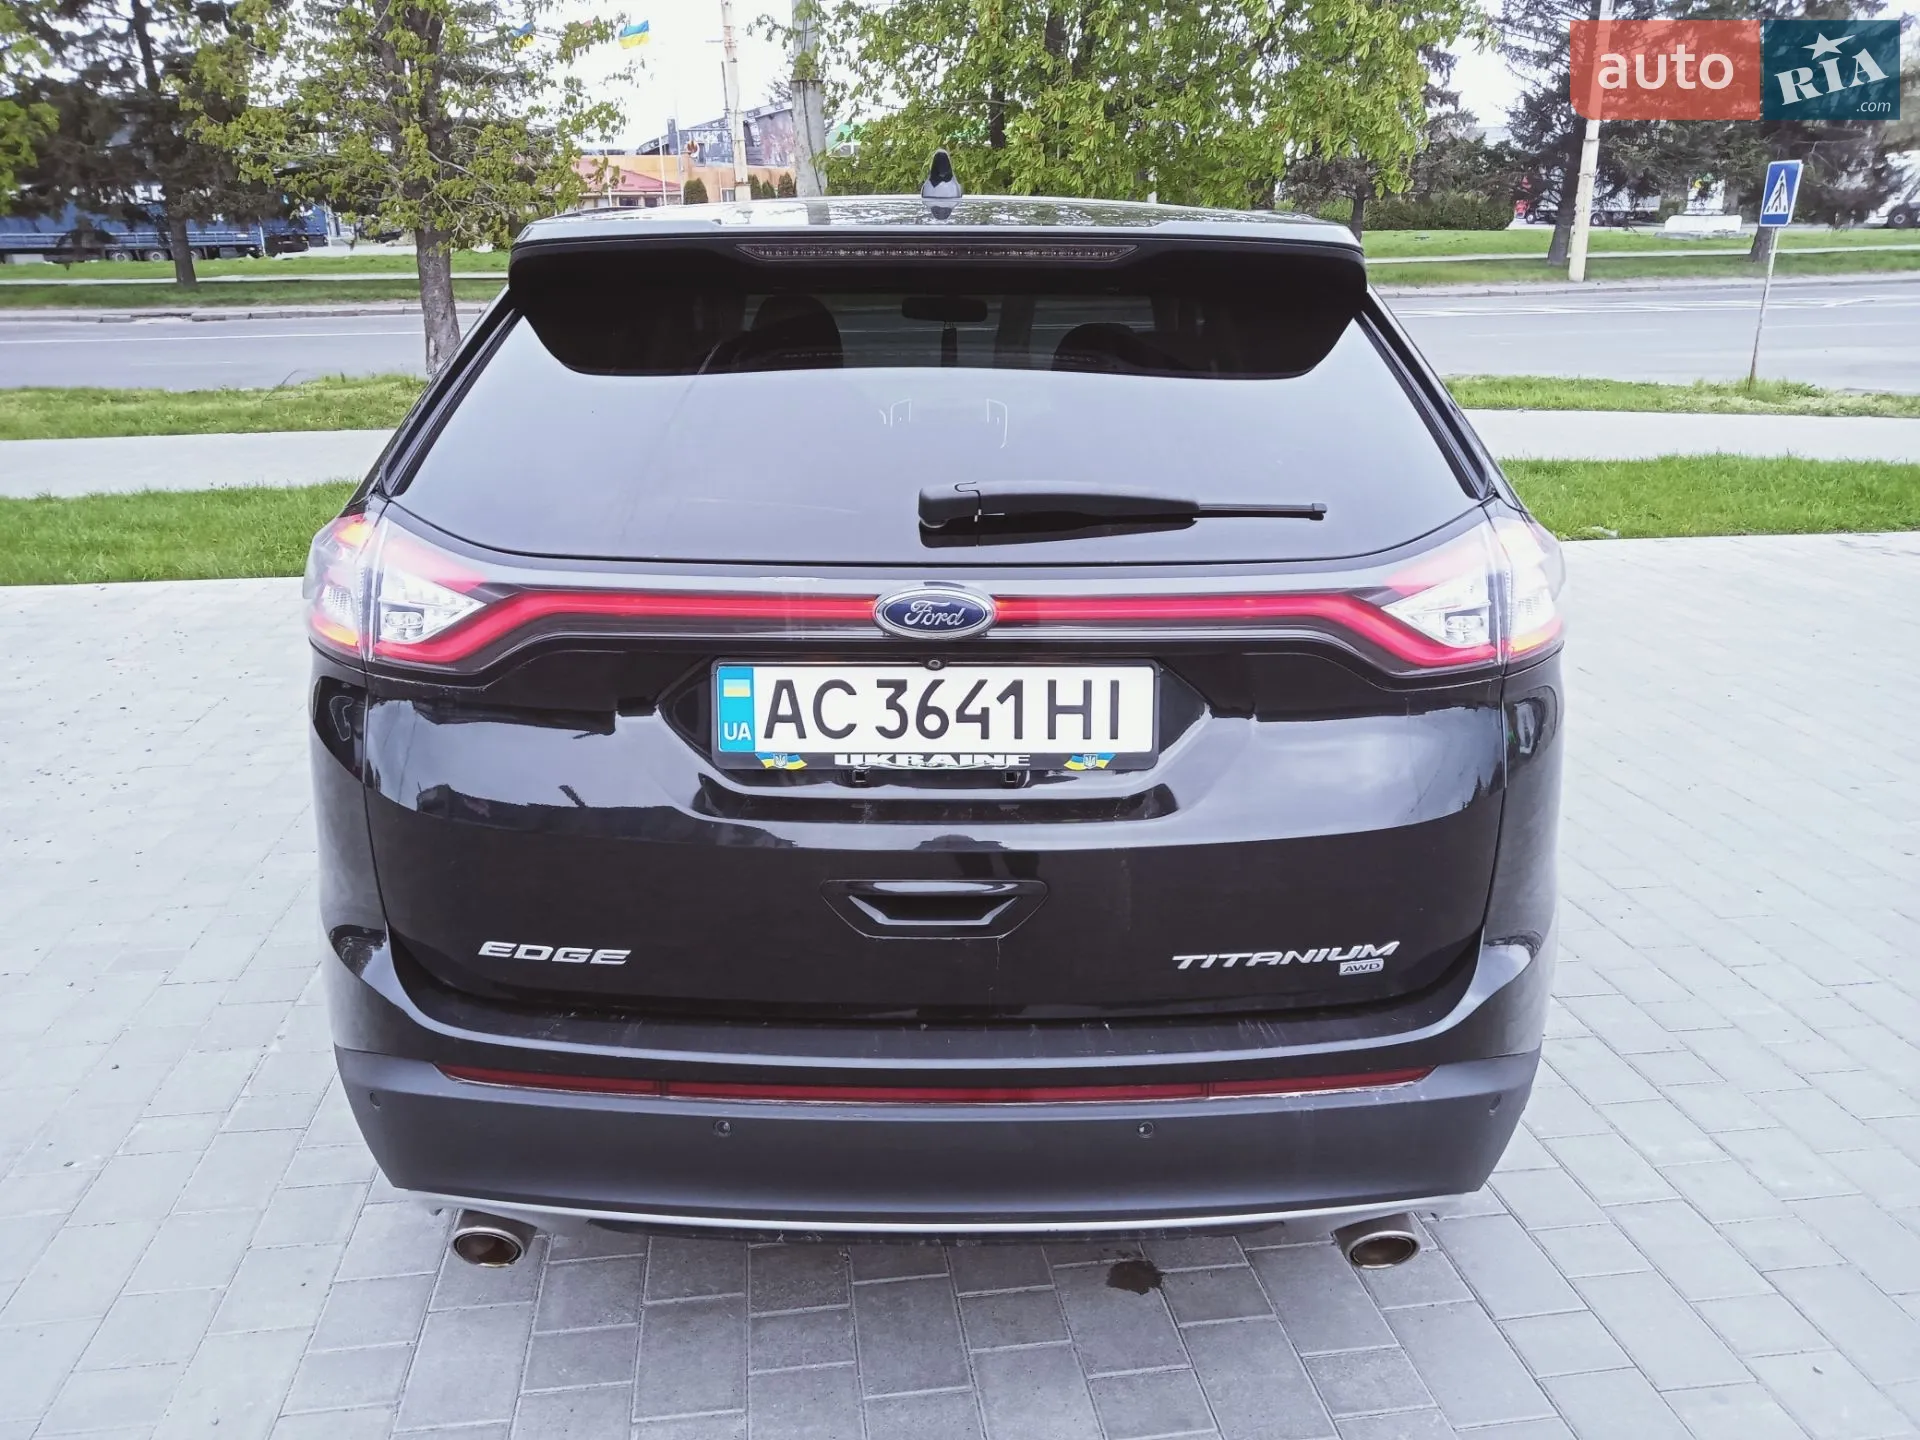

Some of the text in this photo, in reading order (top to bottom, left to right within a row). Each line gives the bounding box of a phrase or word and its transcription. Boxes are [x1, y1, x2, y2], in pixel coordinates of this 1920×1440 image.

[903, 600, 967, 628] Ford
[763, 678, 1120, 740] AC 3641 HI
[723, 721, 752, 741] UA
[834, 753, 1031, 768] UKRAINE
[477, 940, 632, 966] EDGE
[1172, 940, 1400, 970] TITANIUM
[1342, 961, 1382, 973] AWD
